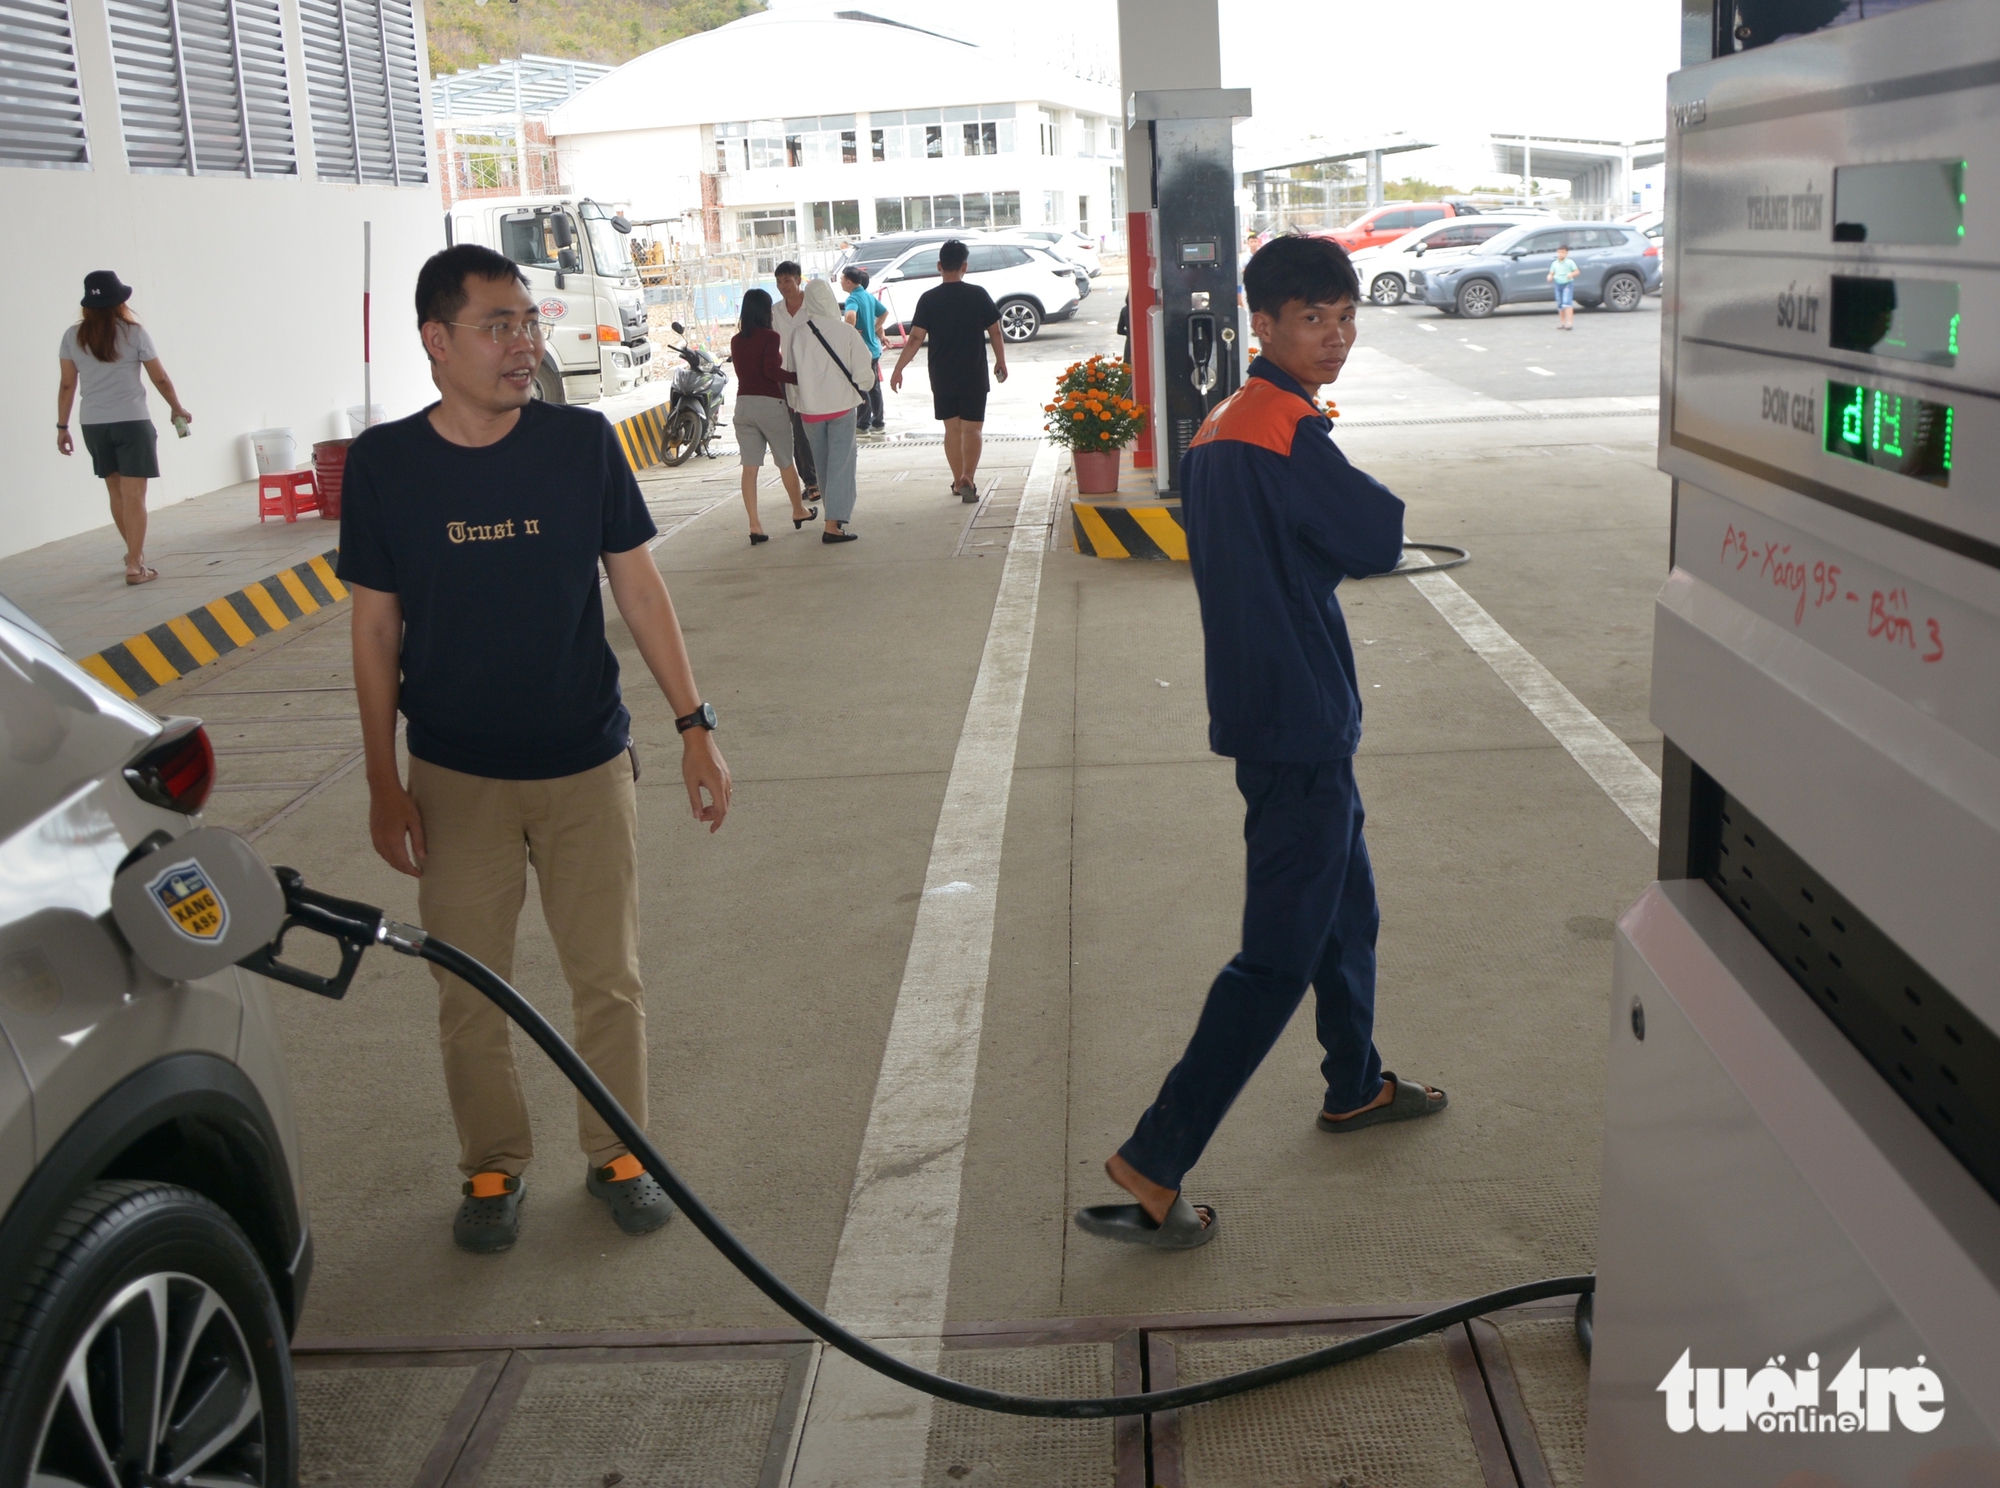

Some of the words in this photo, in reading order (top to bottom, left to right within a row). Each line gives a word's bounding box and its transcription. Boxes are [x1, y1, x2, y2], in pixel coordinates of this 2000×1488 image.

[1777, 280, 1796, 328] SỐ
[1797, 285, 1819, 332] LÍT
[1791, 387, 1815, 434] GIÁ
[446, 518, 516, 544] Trust
[523, 518, 540, 535] n
[192, 911, 218, 933] A95
